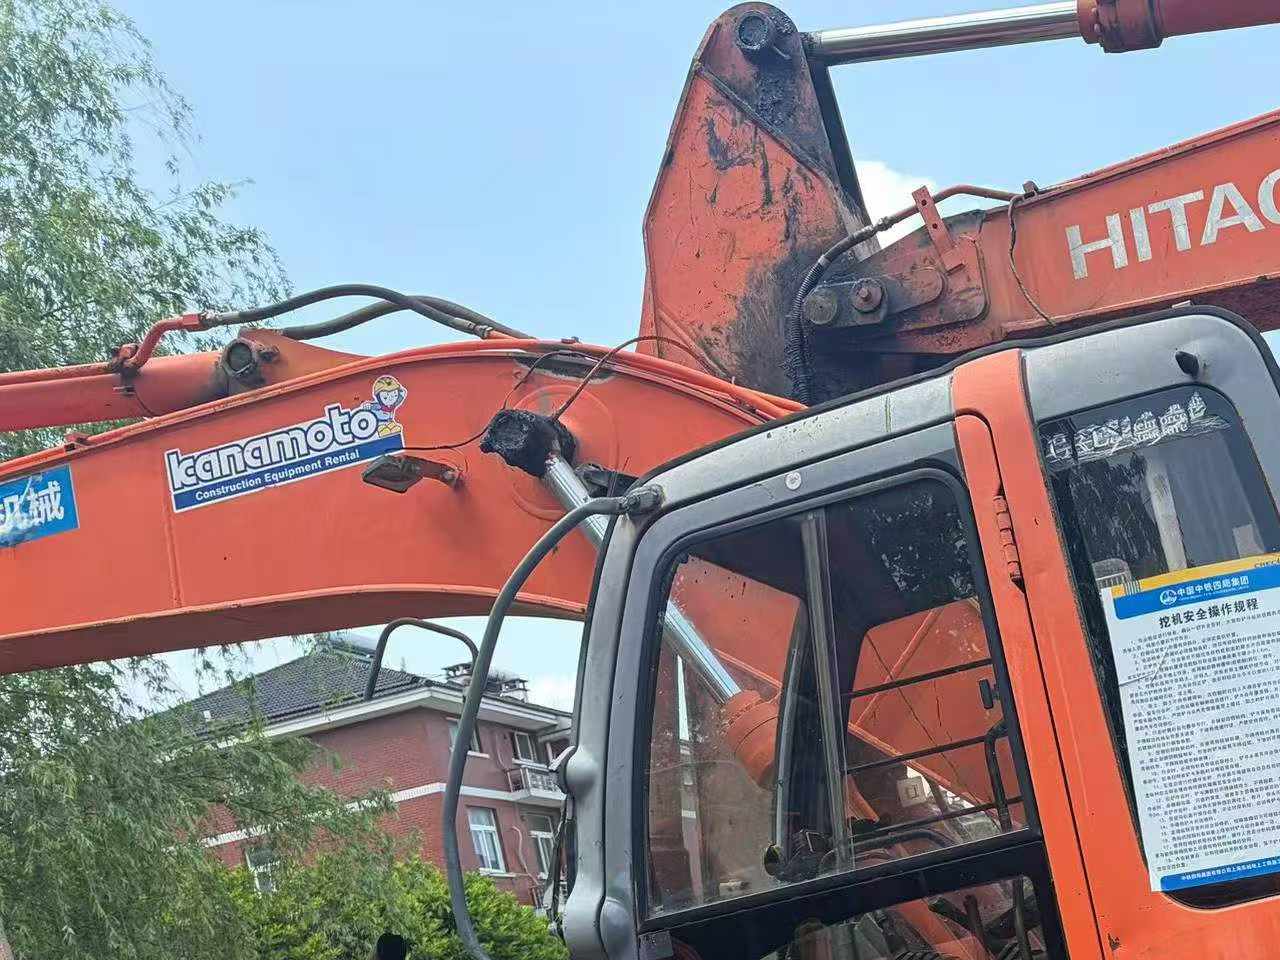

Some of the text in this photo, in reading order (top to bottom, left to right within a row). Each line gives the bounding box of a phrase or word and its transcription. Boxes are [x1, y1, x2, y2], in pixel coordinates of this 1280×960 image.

[167, 404, 379, 490] kanamoto
[195, 450, 361, 501] Construction Equipment Rental
[1158, 596, 1259, 629] 挖机安全操作规程
